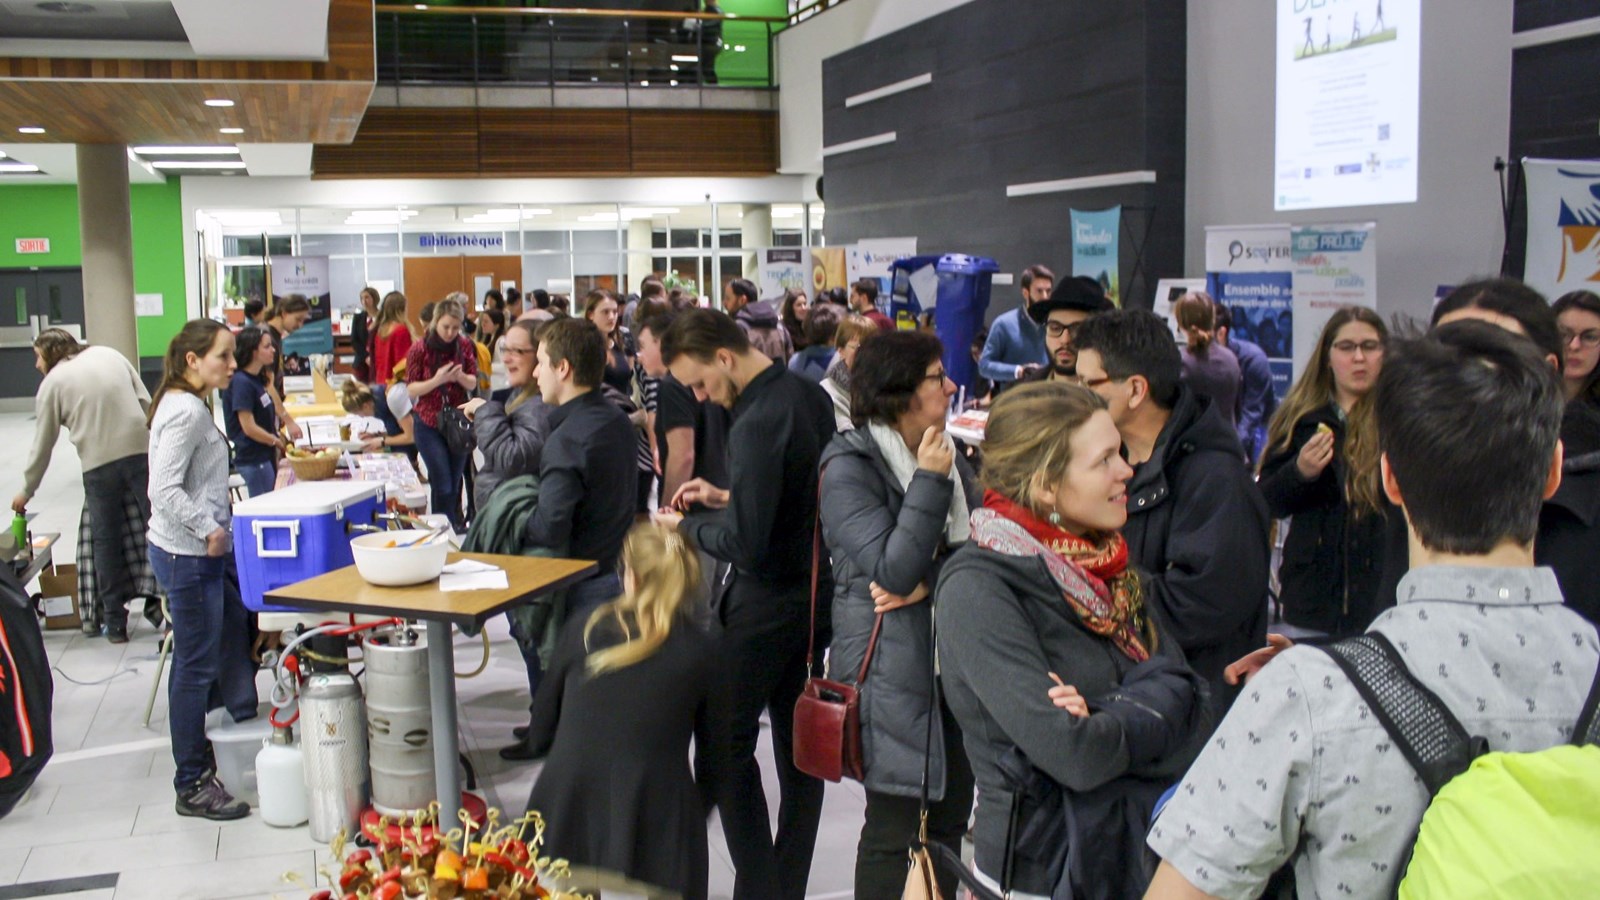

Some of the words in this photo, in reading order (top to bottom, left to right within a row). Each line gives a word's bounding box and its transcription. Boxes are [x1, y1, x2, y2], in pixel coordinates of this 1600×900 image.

[20, 240, 46, 251] SORTIE
[419, 234, 503, 248] Bibliothèque
[1224, 284, 1281, 297] Ensemble
